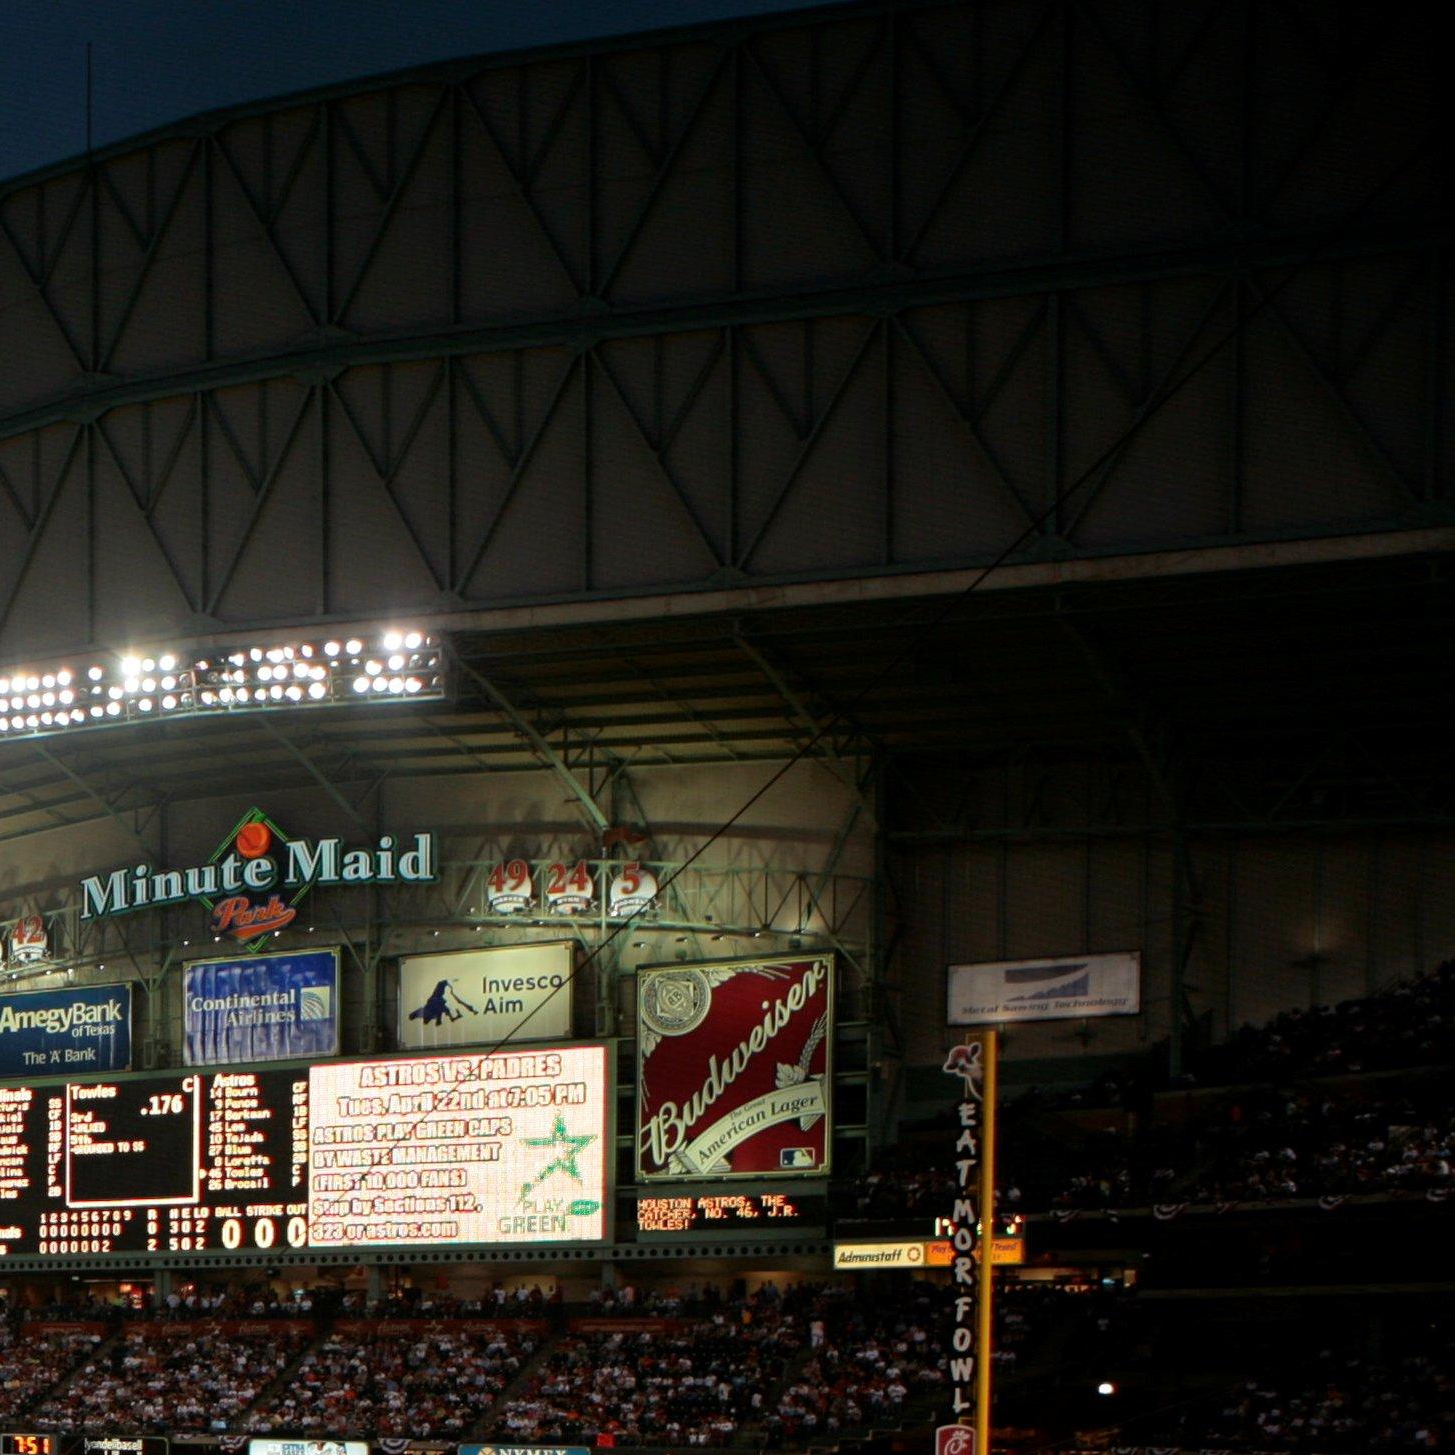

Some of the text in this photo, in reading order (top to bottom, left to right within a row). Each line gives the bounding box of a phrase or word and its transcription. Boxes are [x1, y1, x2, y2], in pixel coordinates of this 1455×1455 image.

[80, 833, 435, 920] Minute Maid
[487, 859, 528, 892] 49
[547, 861, 589, 894] 24
[621, 863, 641, 895] 5
[211, 893, 291, 932] Park
[12, 915, 44, 944] 42
[482, 973, 563, 994] Invesco
[190, 988, 296, 1012] Continental
[483, 997, 524, 1015] Aim
[226, 1008, 296, 1027] Airlines
[72, 1024, 115, 1038] of Texas
[23, 1051, 46, 1065] The
[65, 1047, 96, 1063] Bank
[640, 960, 825, 1166] Budweiser
[213, 1074, 255, 1088] Astros
[360, 1061, 439, 1088] ASTROS
[479, 1054, 561, 1081] PADRES
[70, 1085, 117, 1100] Towles
[141, 1094, 183, 1115] .176
[389, 1091, 434, 1115] April
[436, 1088, 485, 1112] 22nd
[488, 1088, 507, 1109] at
[507, 1085, 552, 1107] 7:05
[554, 1082, 586, 1105] PM
[313, 1116, 512, 1146] ASTROS PLAY GREEN CAPS
[697, 1109, 766, 1165] American
[771, 1094, 819, 1116] Lager
[313, 1150, 336, 1169] BY
[391, 1142, 501, 1165] MANAGEMENT
[313, 1174, 363, 1193] (FIRST
[365, 1171, 419, 1192] 10,000
[215, 1204, 308, 1217] BALL STRIKE OUT
[312, 1197, 350, 1219] Stop
[352, 1197, 372, 1218] by
[374, 1194, 446, 1215] Sections
[638, 1198, 691, 1210] HOUSTON
[760, 1194, 787, 1207] THE
[704, 1207, 728, 1219] NO.
[767, 1205, 799, 1217] J.R.
[221, 1216, 307, 1249] 0 0 0
[312, 1221, 459, 1241] 323 or astros.com
[499, 1215, 567, 1235] GREEN
[638, 1219, 689, 1231] TOWLES!
[949, 1101, 979, 1414] EAT MOR FOWL
